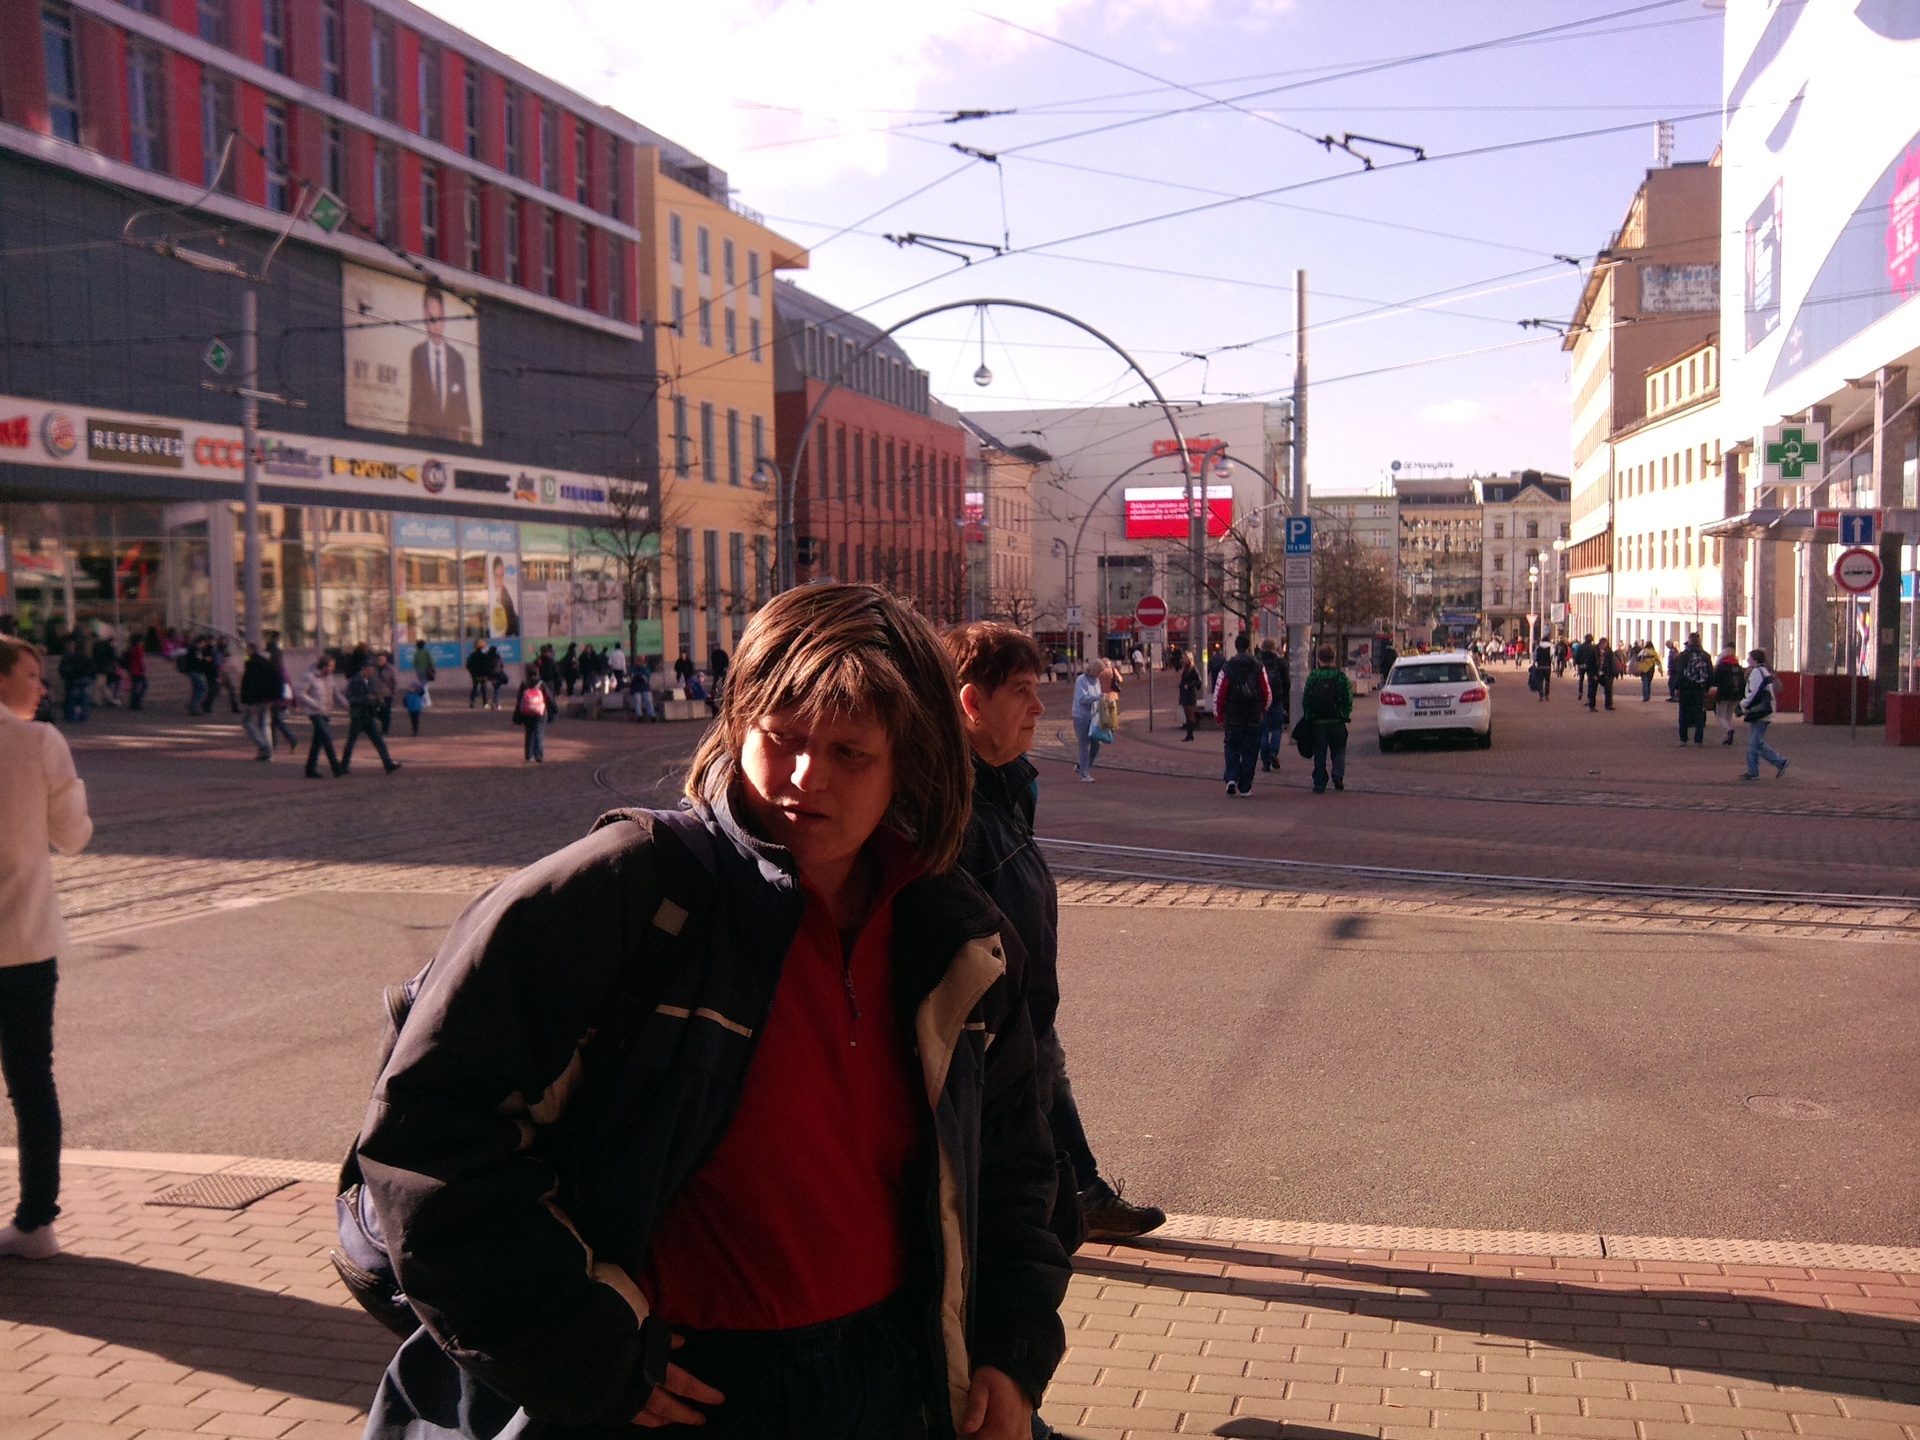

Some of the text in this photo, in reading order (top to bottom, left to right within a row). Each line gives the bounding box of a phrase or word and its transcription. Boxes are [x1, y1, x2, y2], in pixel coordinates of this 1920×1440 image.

[91, 428, 183, 458] RESERVED
[193, 436, 245, 468] CCC
[1290, 520, 1307, 543] P
